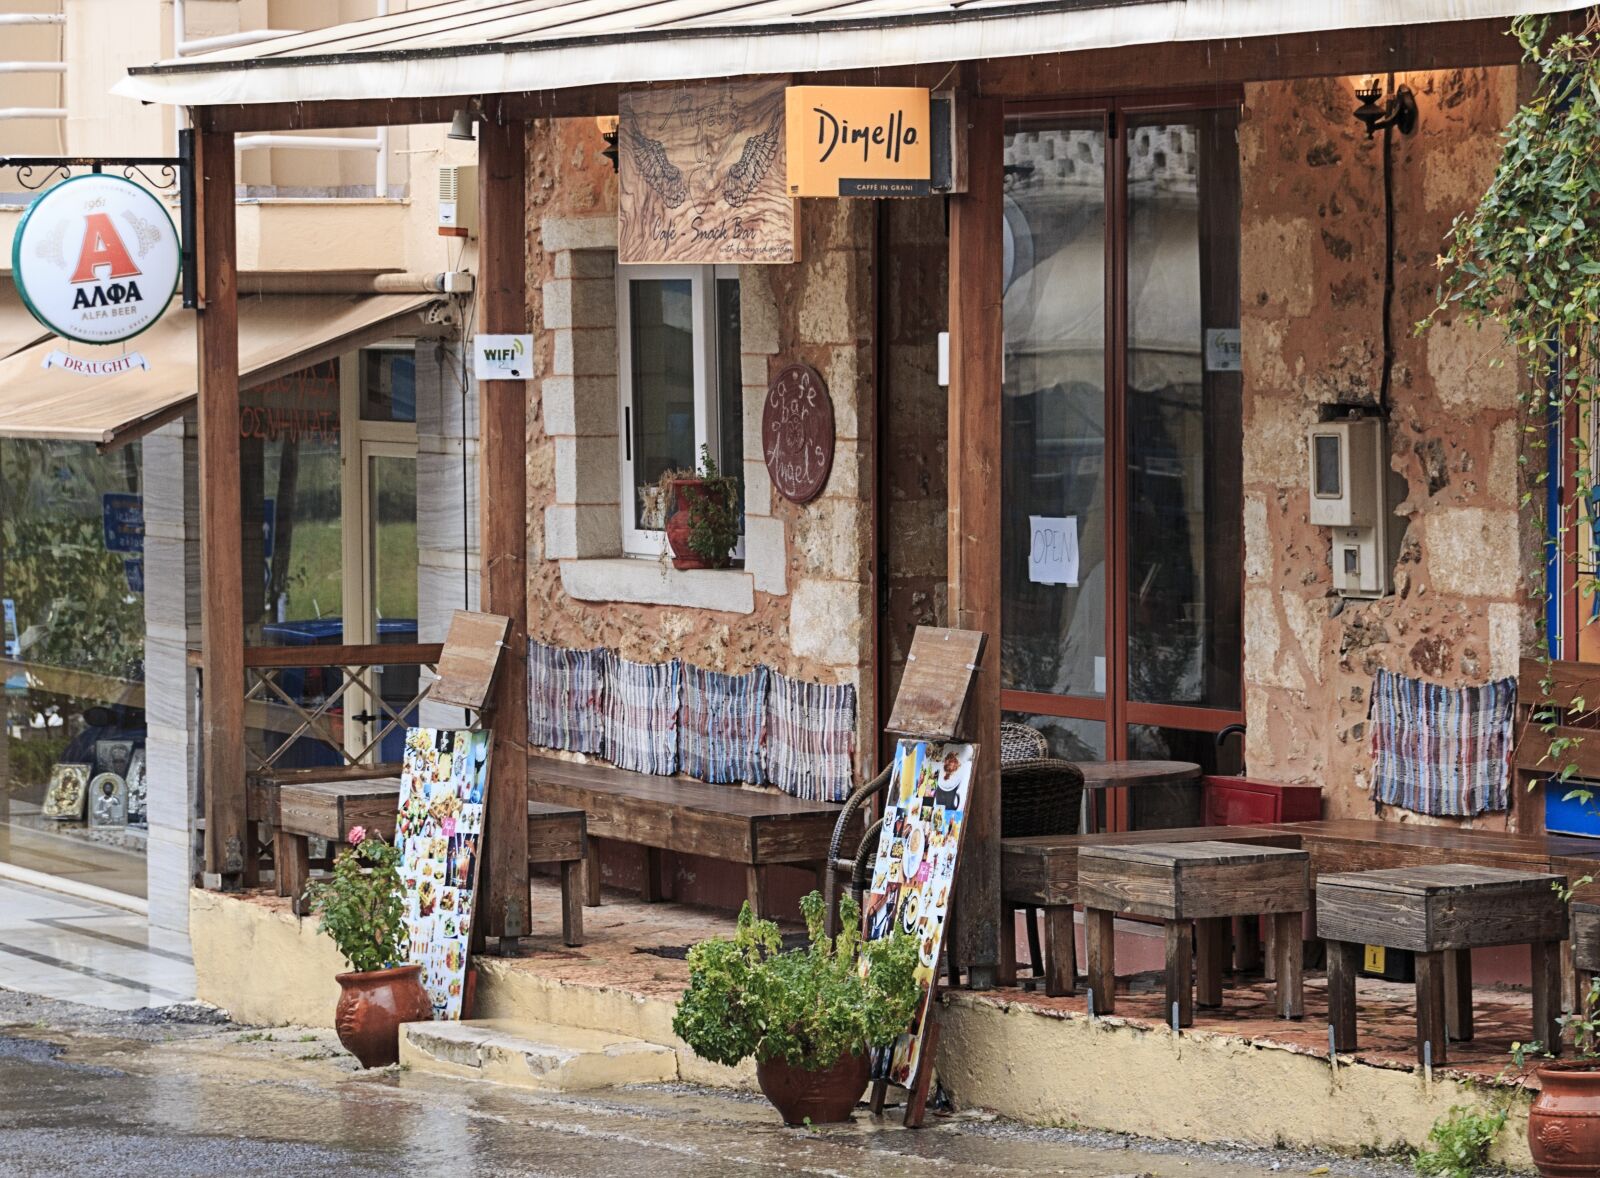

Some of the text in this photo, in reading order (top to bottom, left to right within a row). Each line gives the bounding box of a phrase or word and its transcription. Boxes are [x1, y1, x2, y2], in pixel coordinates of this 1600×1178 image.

[813, 108, 917, 162] Dimello
[691, 216, 728, 243] Snack
[733, 216, 756, 240] Bar
[72, 281, 144, 310] ΑΛΦΑ
[82, 306, 137, 321] ALFA BEER
[63, 356, 131, 374] DRAUGHT
[483, 348, 515, 361] WIFI
[767, 432, 825, 496] Angel's
[1033, 528, 1073, 565] OPEN
